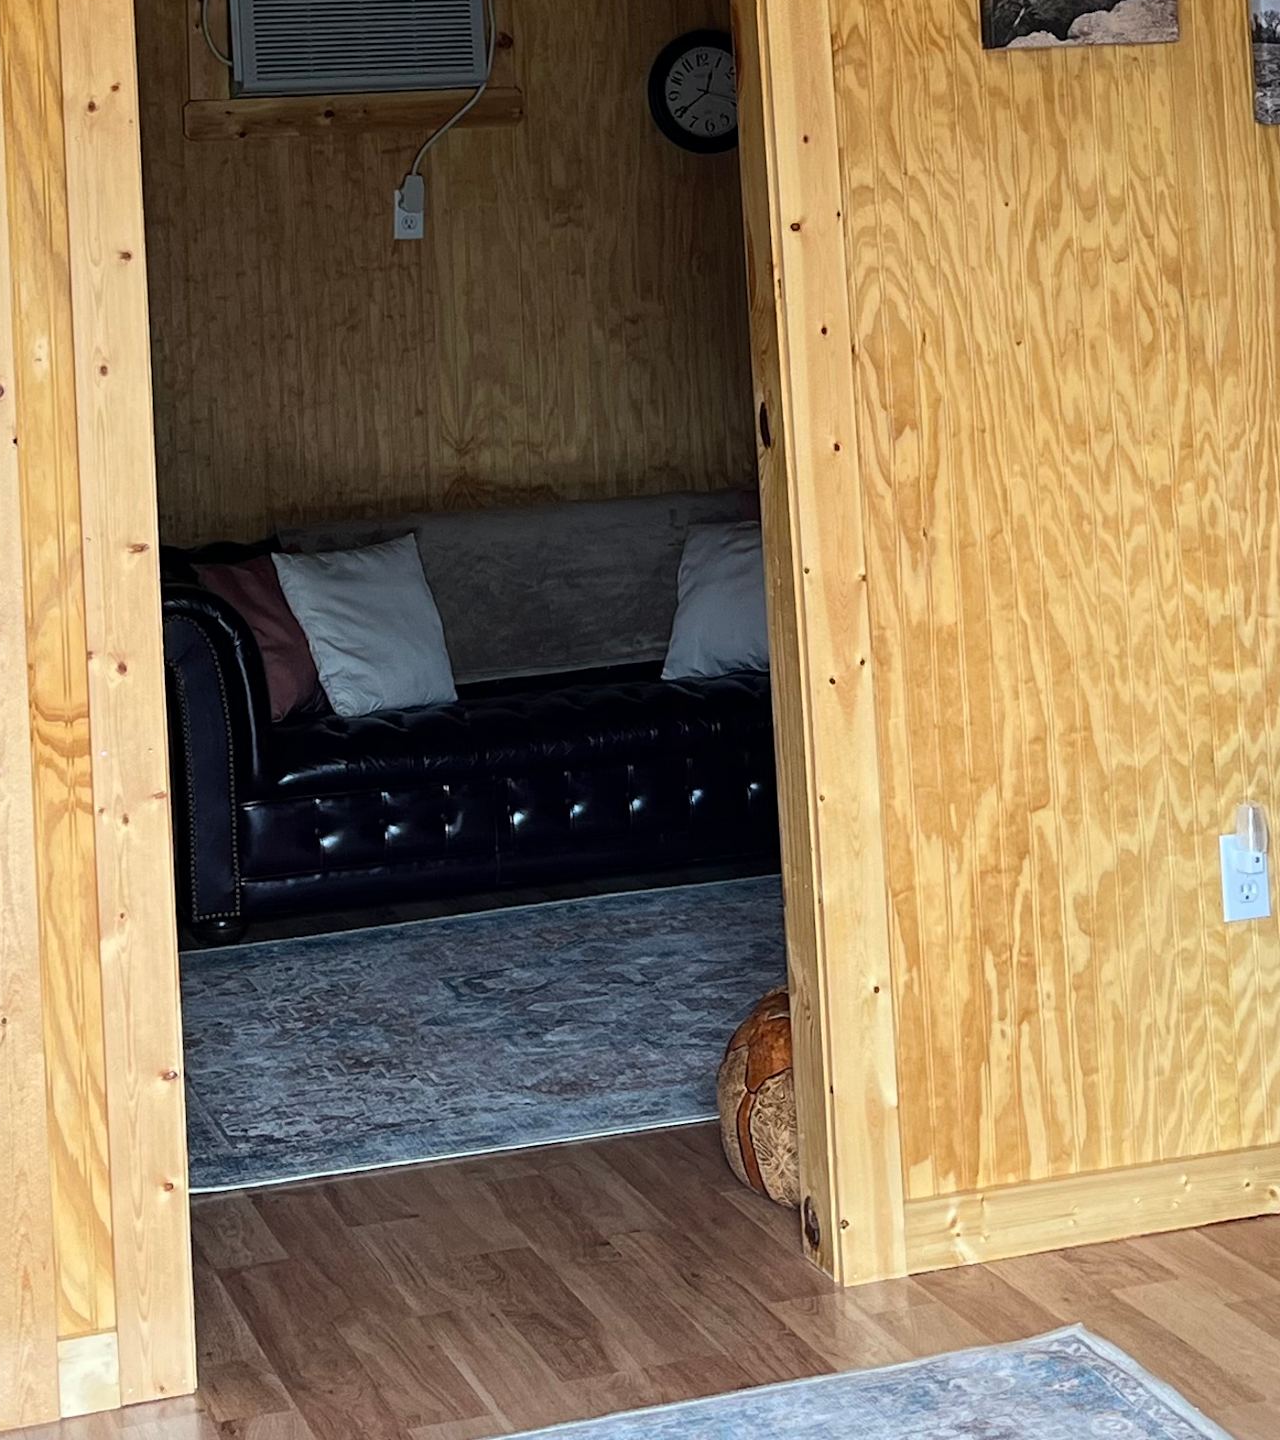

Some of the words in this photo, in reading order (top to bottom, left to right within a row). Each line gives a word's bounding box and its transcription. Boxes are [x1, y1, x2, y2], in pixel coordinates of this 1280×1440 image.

[682, 58, 694, 73] 11
[696, 53, 709, 66] 12
[671, 71, 684, 86] 10
[668, 90, 680, 101] 9
[689, 116, 699, 128] 7
[705, 119, 715, 132] 6
